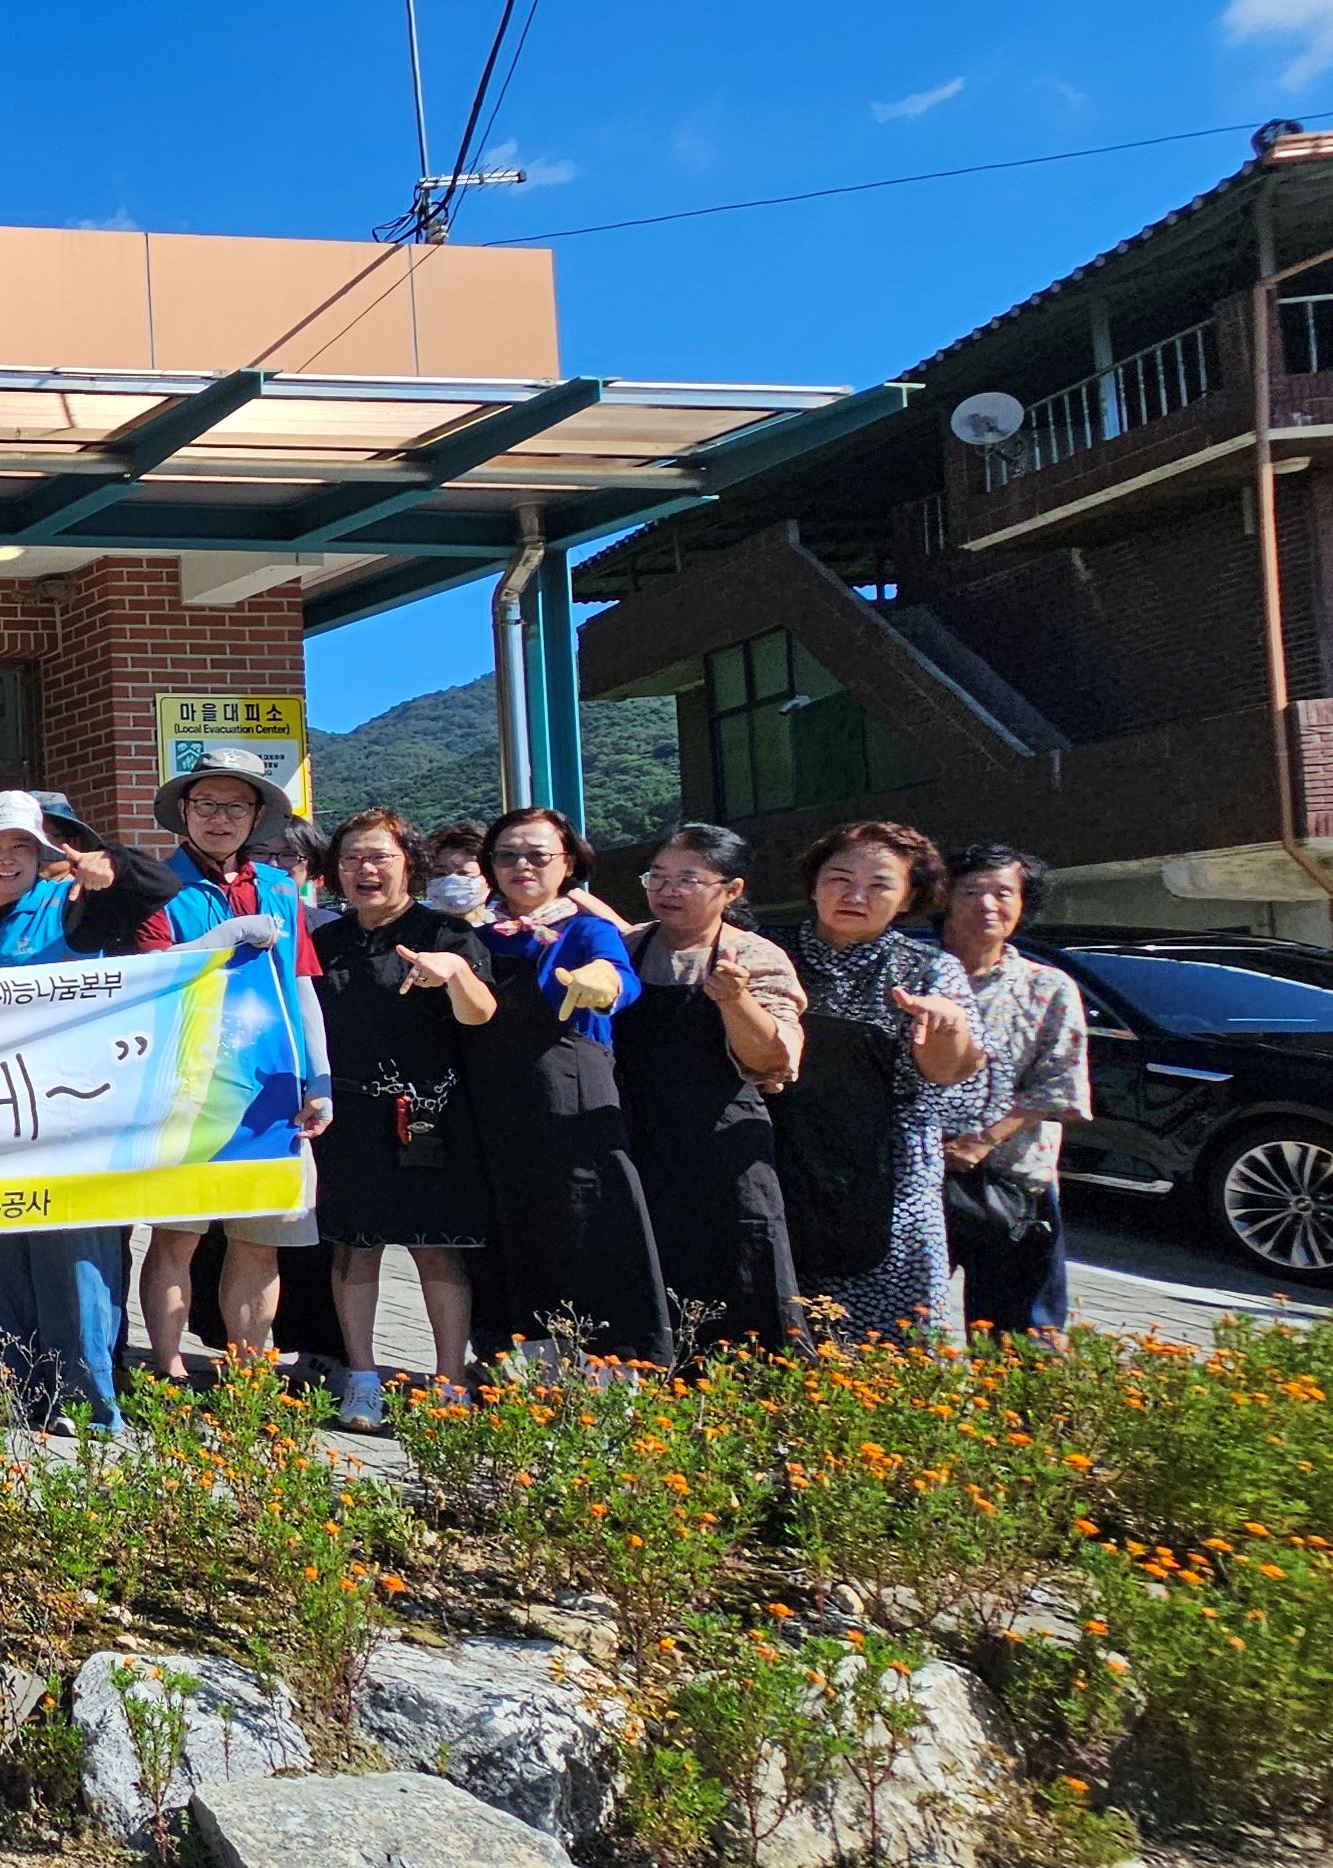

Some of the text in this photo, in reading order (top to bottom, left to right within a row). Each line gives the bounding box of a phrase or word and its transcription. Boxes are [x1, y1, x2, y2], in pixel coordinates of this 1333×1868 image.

[180, 703, 283, 722] 마을대피소
[174, 723, 291, 735] (Local Evacuation Center)
